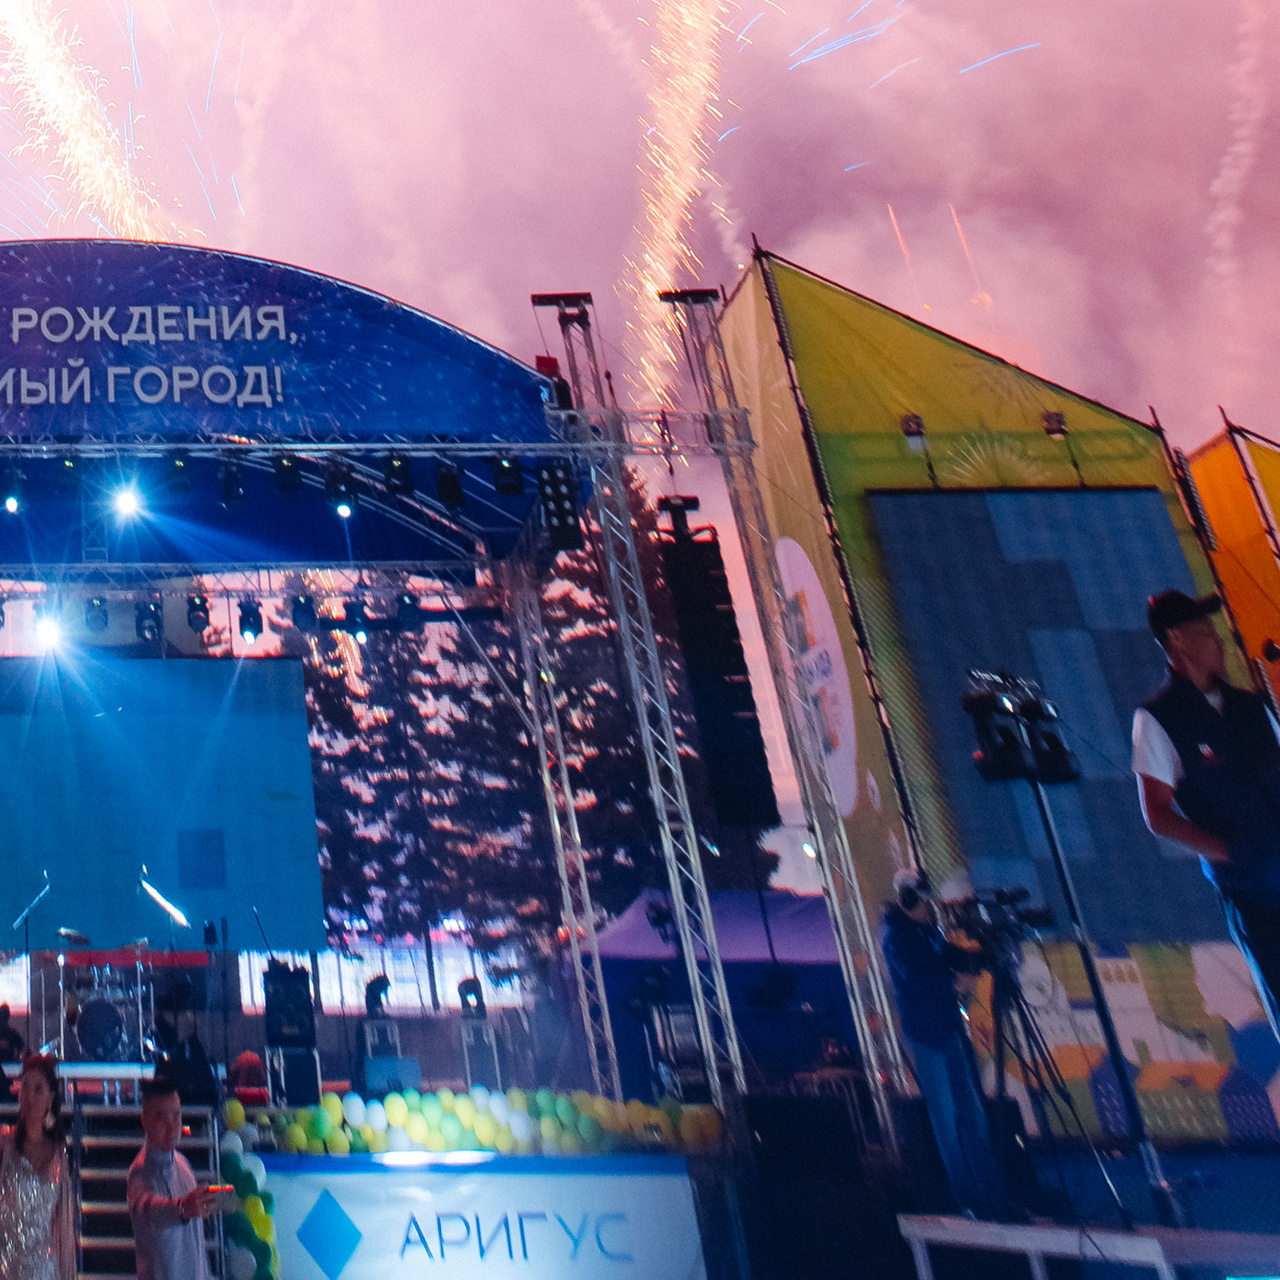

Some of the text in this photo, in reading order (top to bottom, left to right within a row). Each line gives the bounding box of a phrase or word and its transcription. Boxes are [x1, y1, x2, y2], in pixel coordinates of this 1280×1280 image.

[12, 305, 298, 346] РОЖДЕНИЯ,
[107, 364, 284, 409] ГОРОД!
[399, 1210, 634, 1261] АРИГУС
